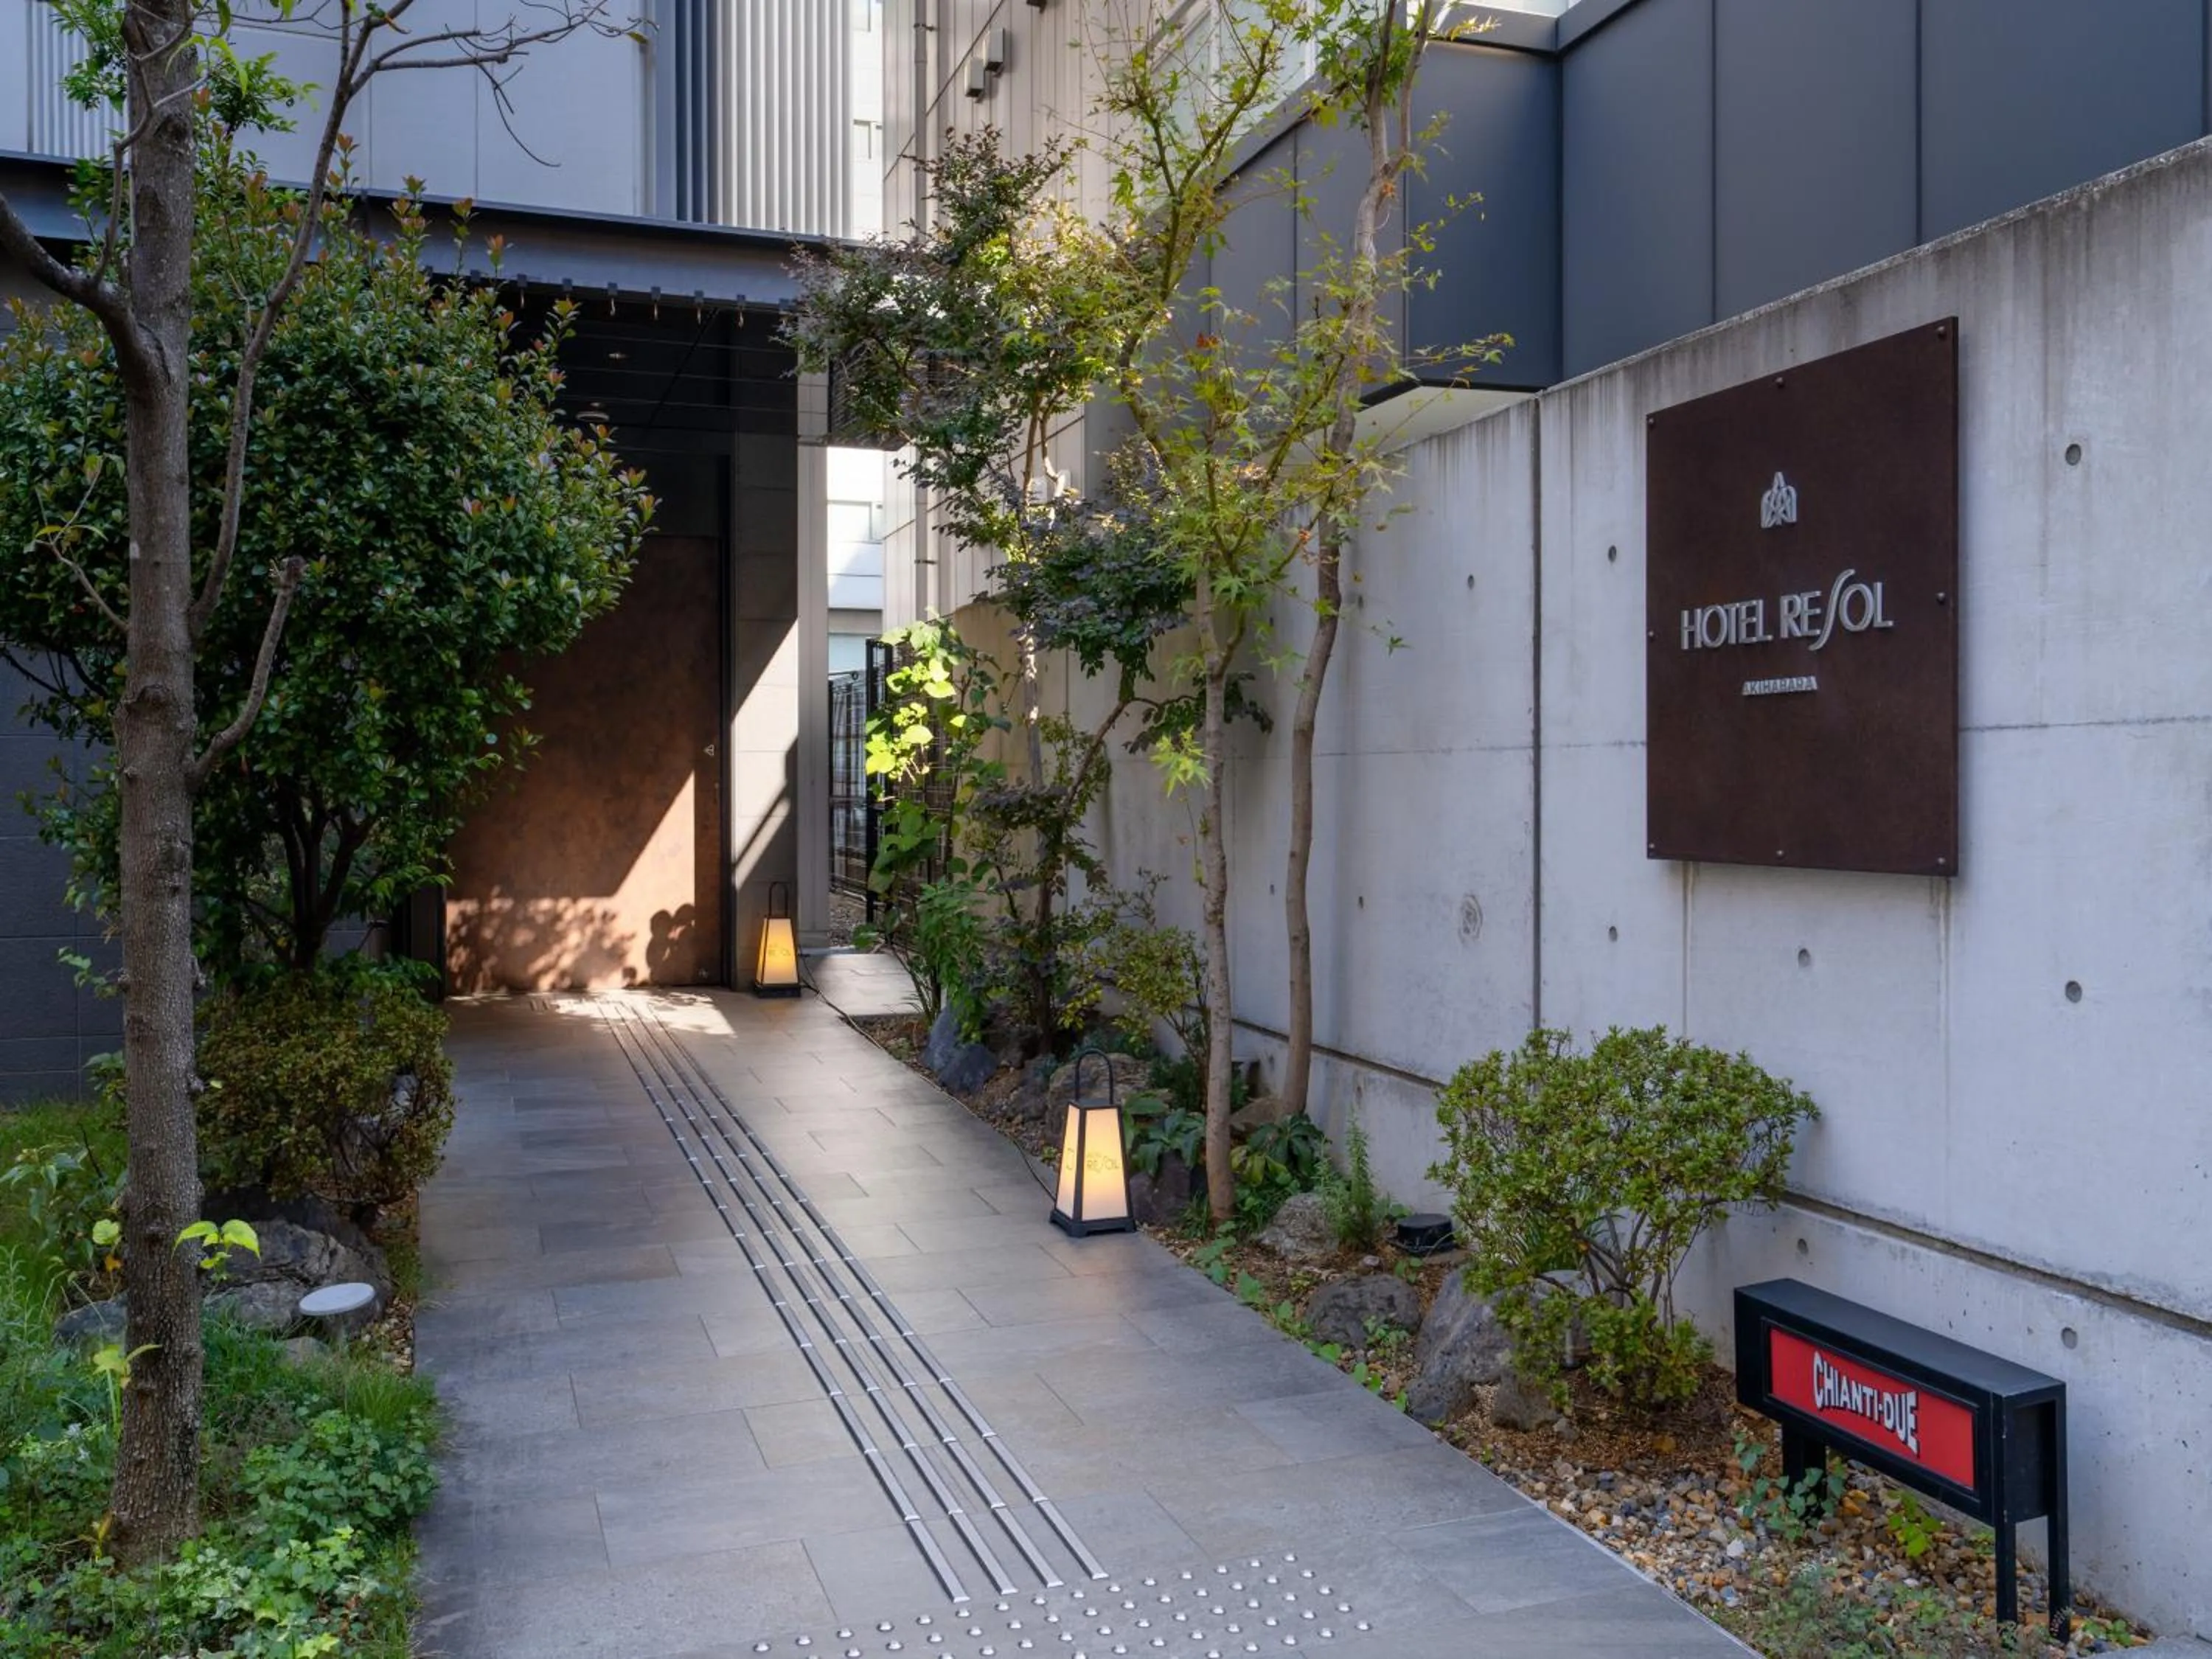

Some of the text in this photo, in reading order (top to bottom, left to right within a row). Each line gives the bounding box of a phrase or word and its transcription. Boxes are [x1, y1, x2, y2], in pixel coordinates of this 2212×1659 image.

[1680, 568, 1893, 651] HOTEL RESOL
[1742, 675, 1818, 696] AKIHABARA
